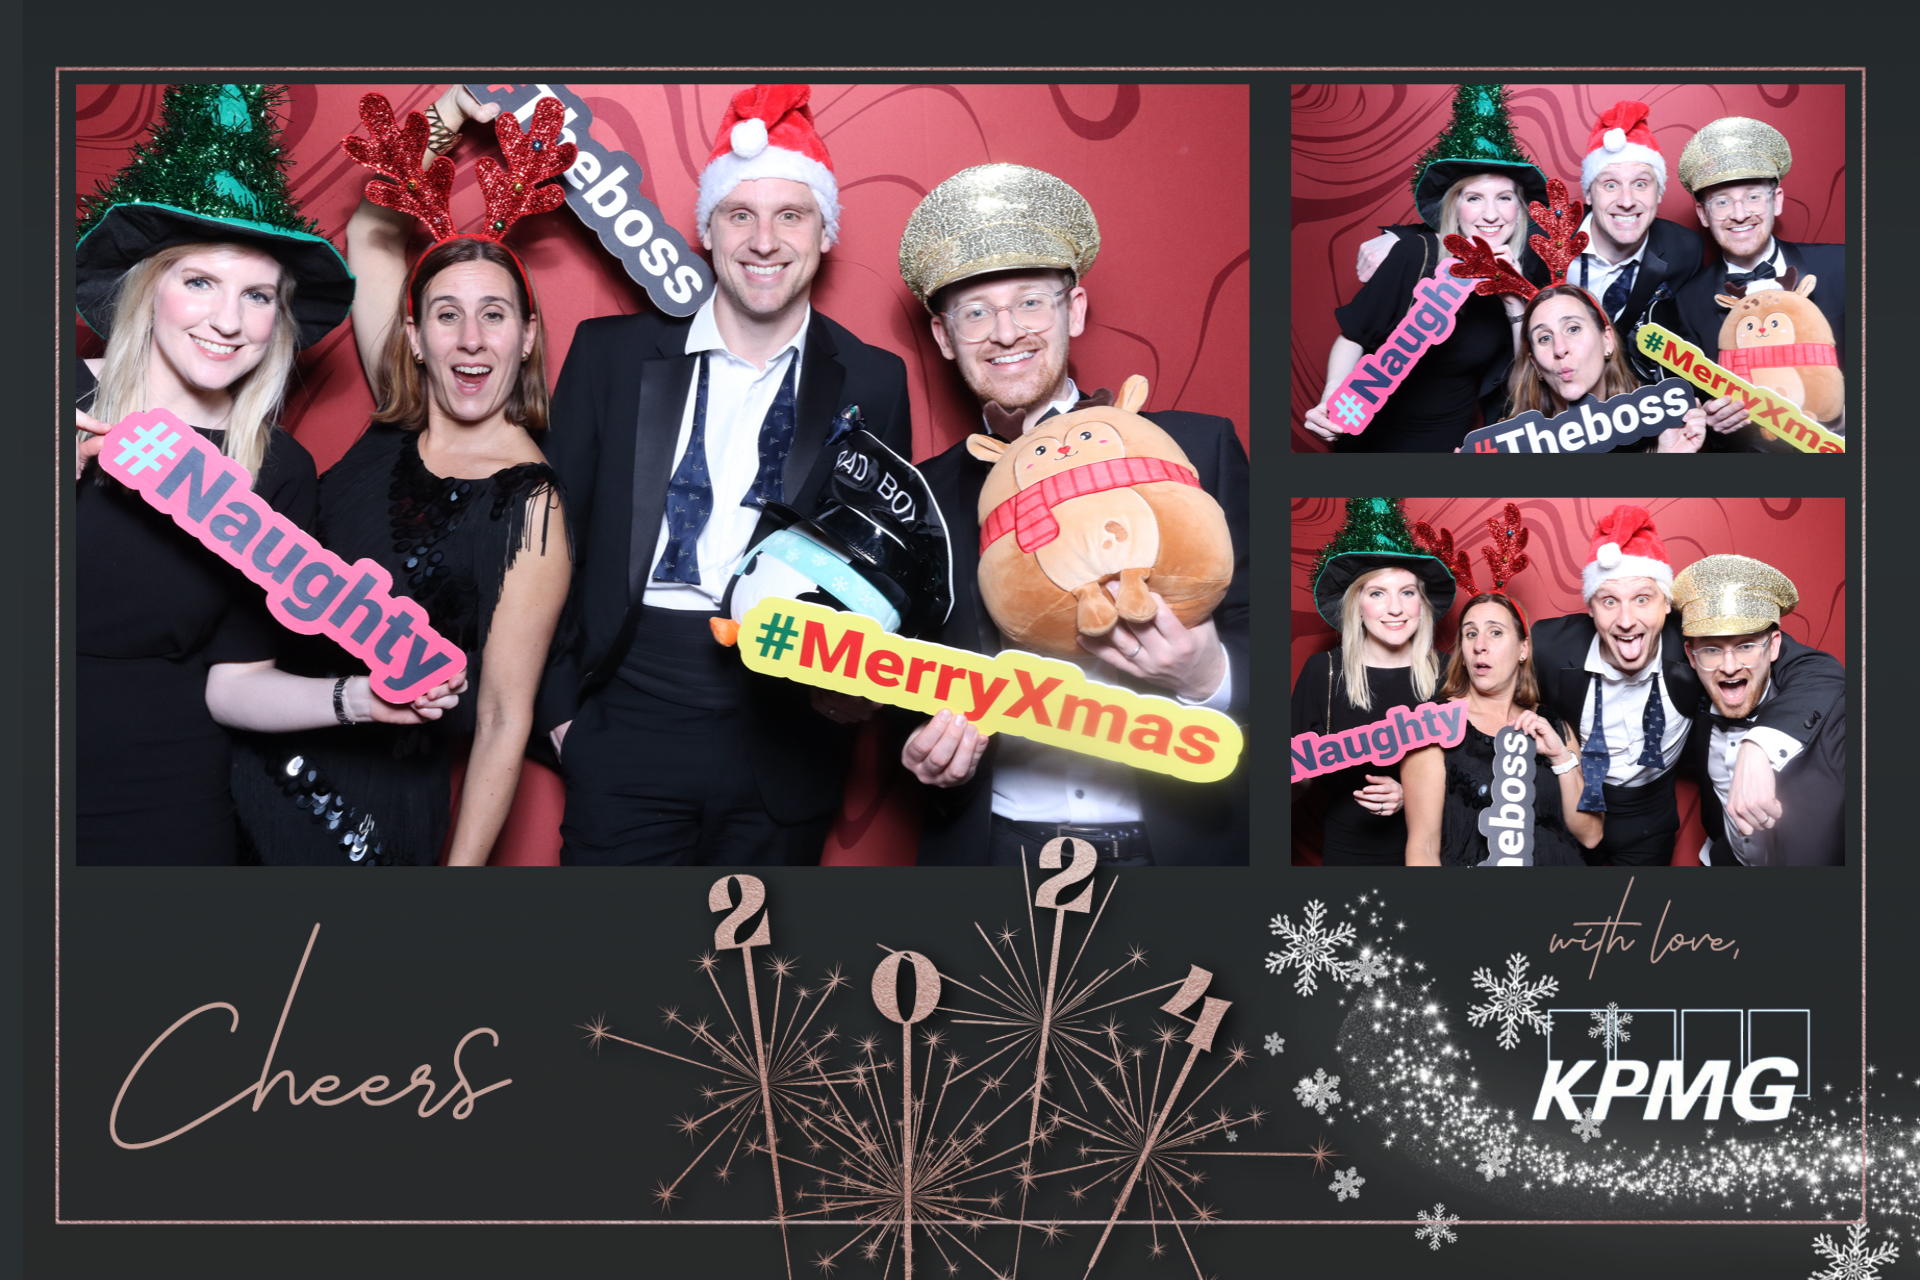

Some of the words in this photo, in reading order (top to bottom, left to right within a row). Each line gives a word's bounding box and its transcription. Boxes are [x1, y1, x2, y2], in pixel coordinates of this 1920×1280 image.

[113, 421, 452, 691] #Naughty
[755, 612, 1221, 765] #MerryXmas
[1291, 706, 1462, 776] Naughty
